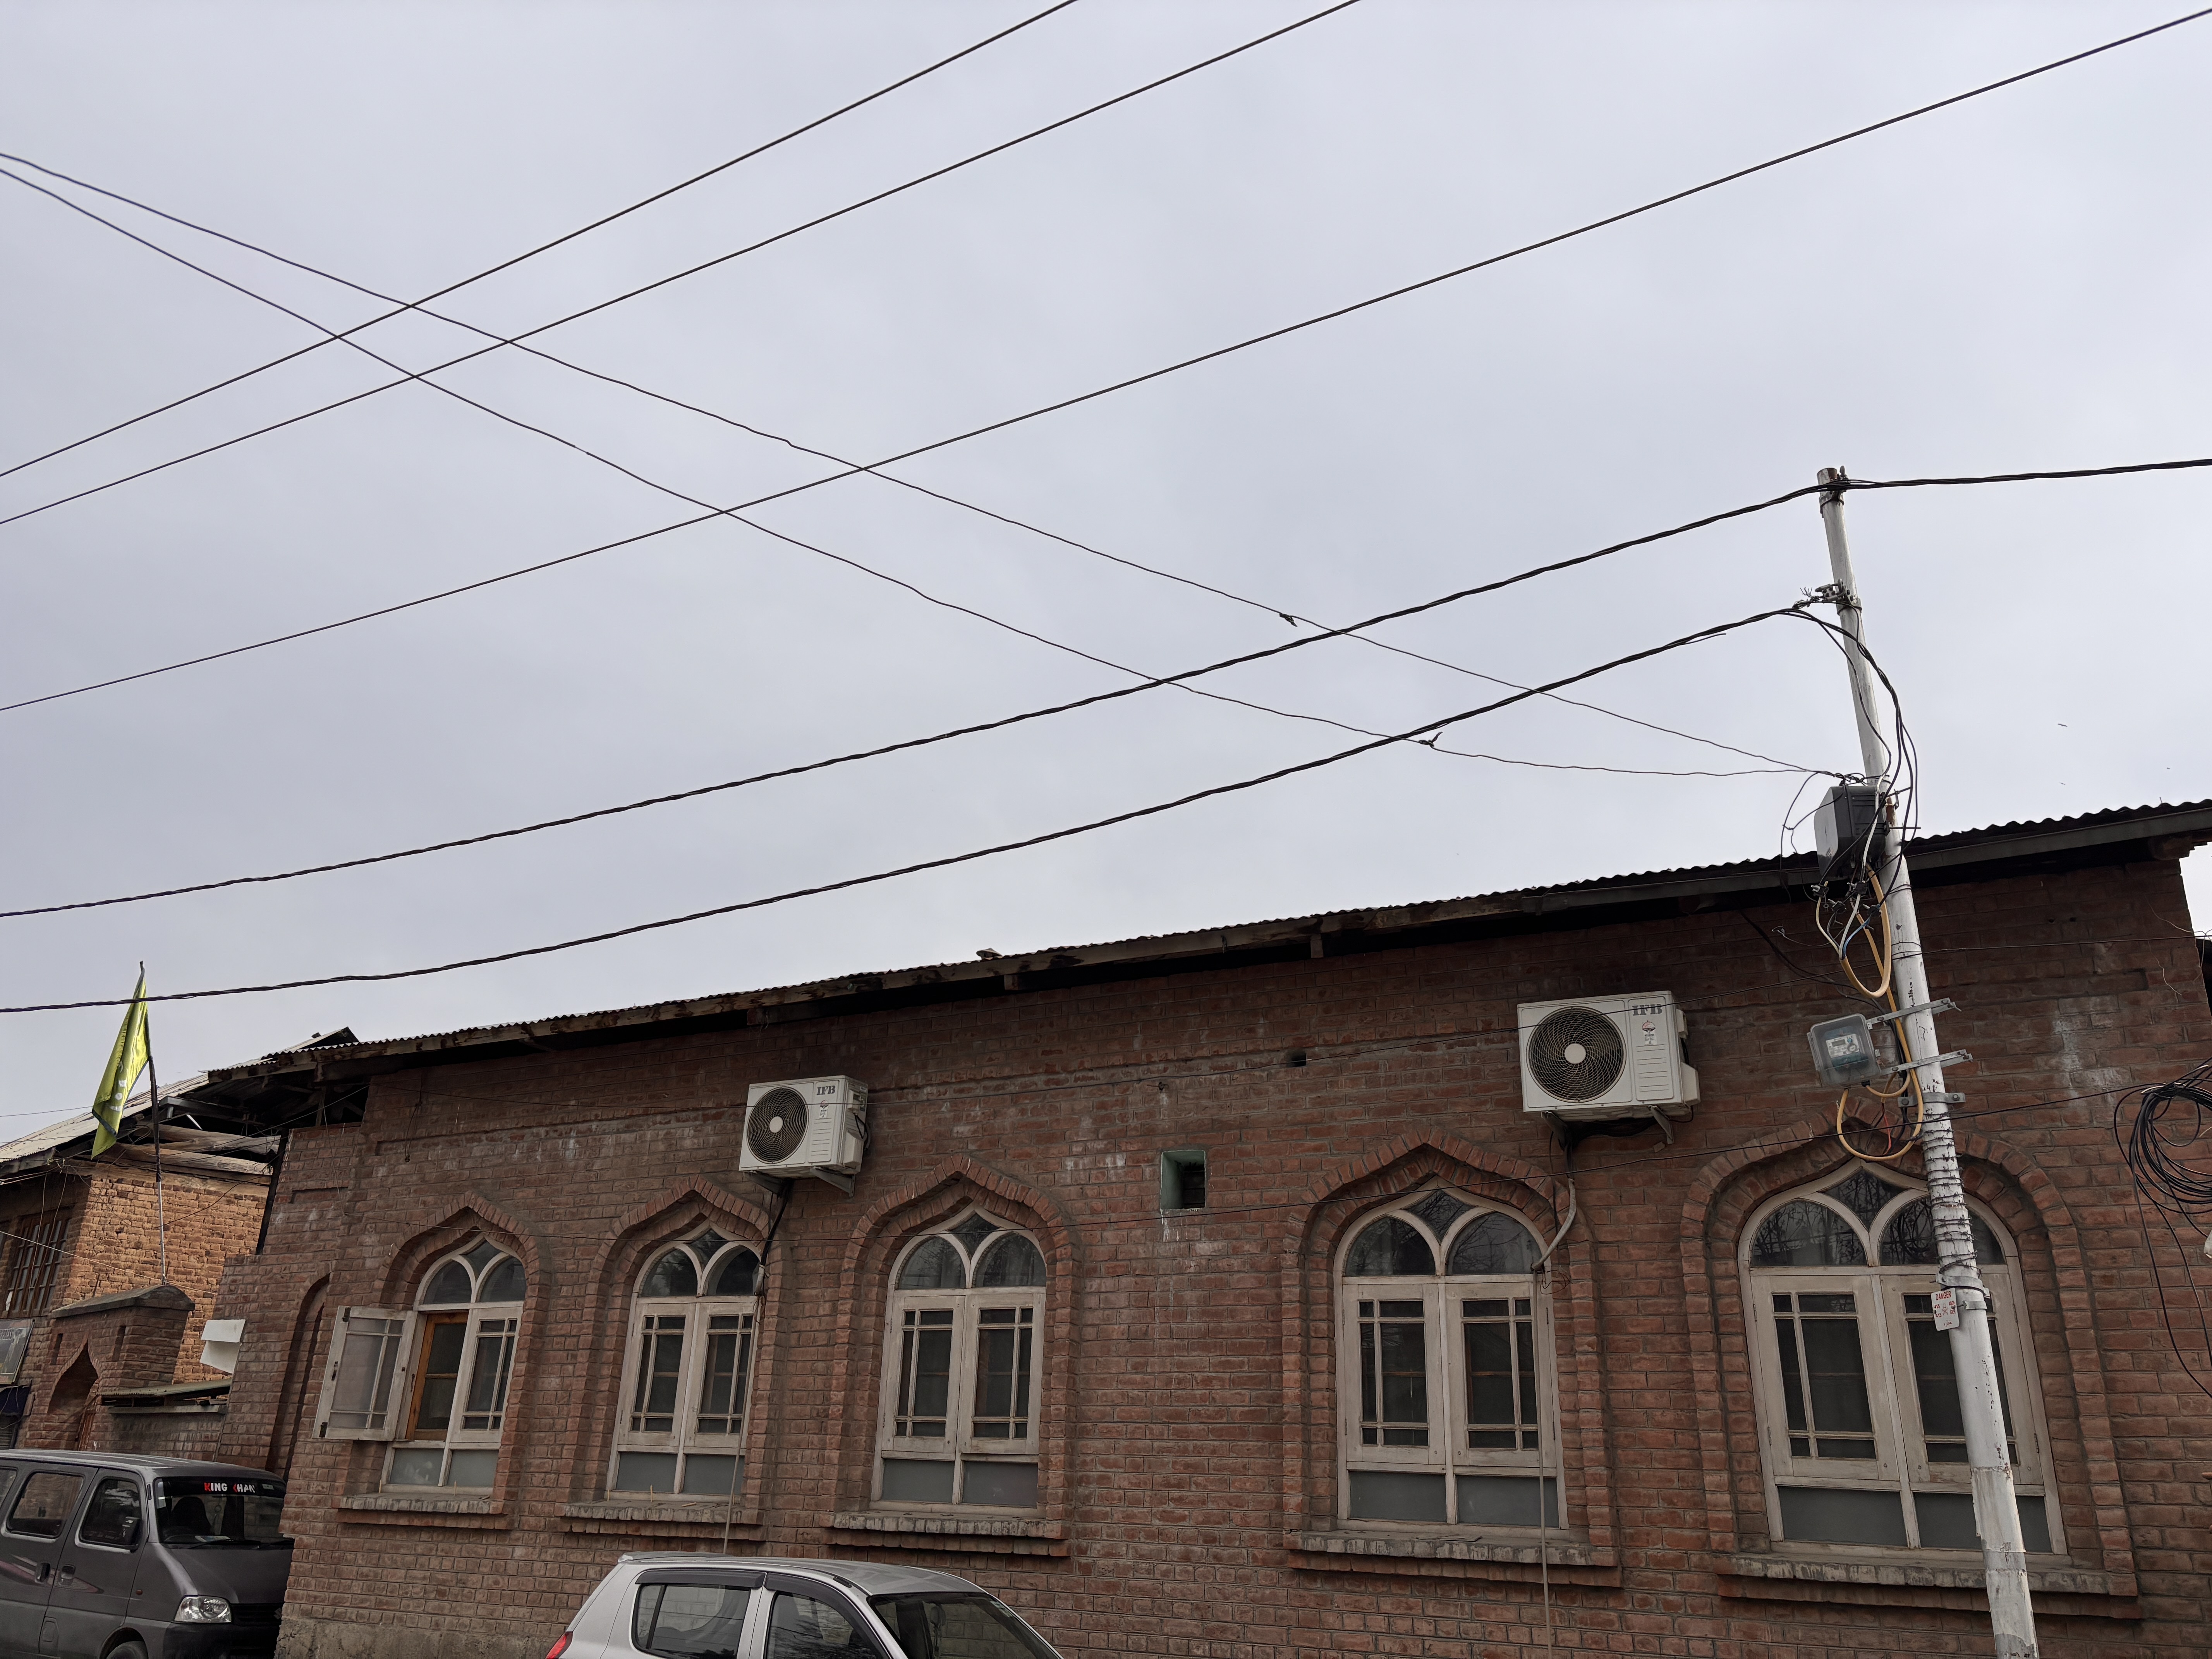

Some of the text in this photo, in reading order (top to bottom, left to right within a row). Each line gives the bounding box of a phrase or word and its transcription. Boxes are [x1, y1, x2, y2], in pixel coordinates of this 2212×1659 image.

[1632, 1004, 1662, 1016] IFB
[816, 1085, 836, 1095] IFB
[1936, 1291, 1951, 1300] DANGER
[204, 1482, 228, 1492] KING
